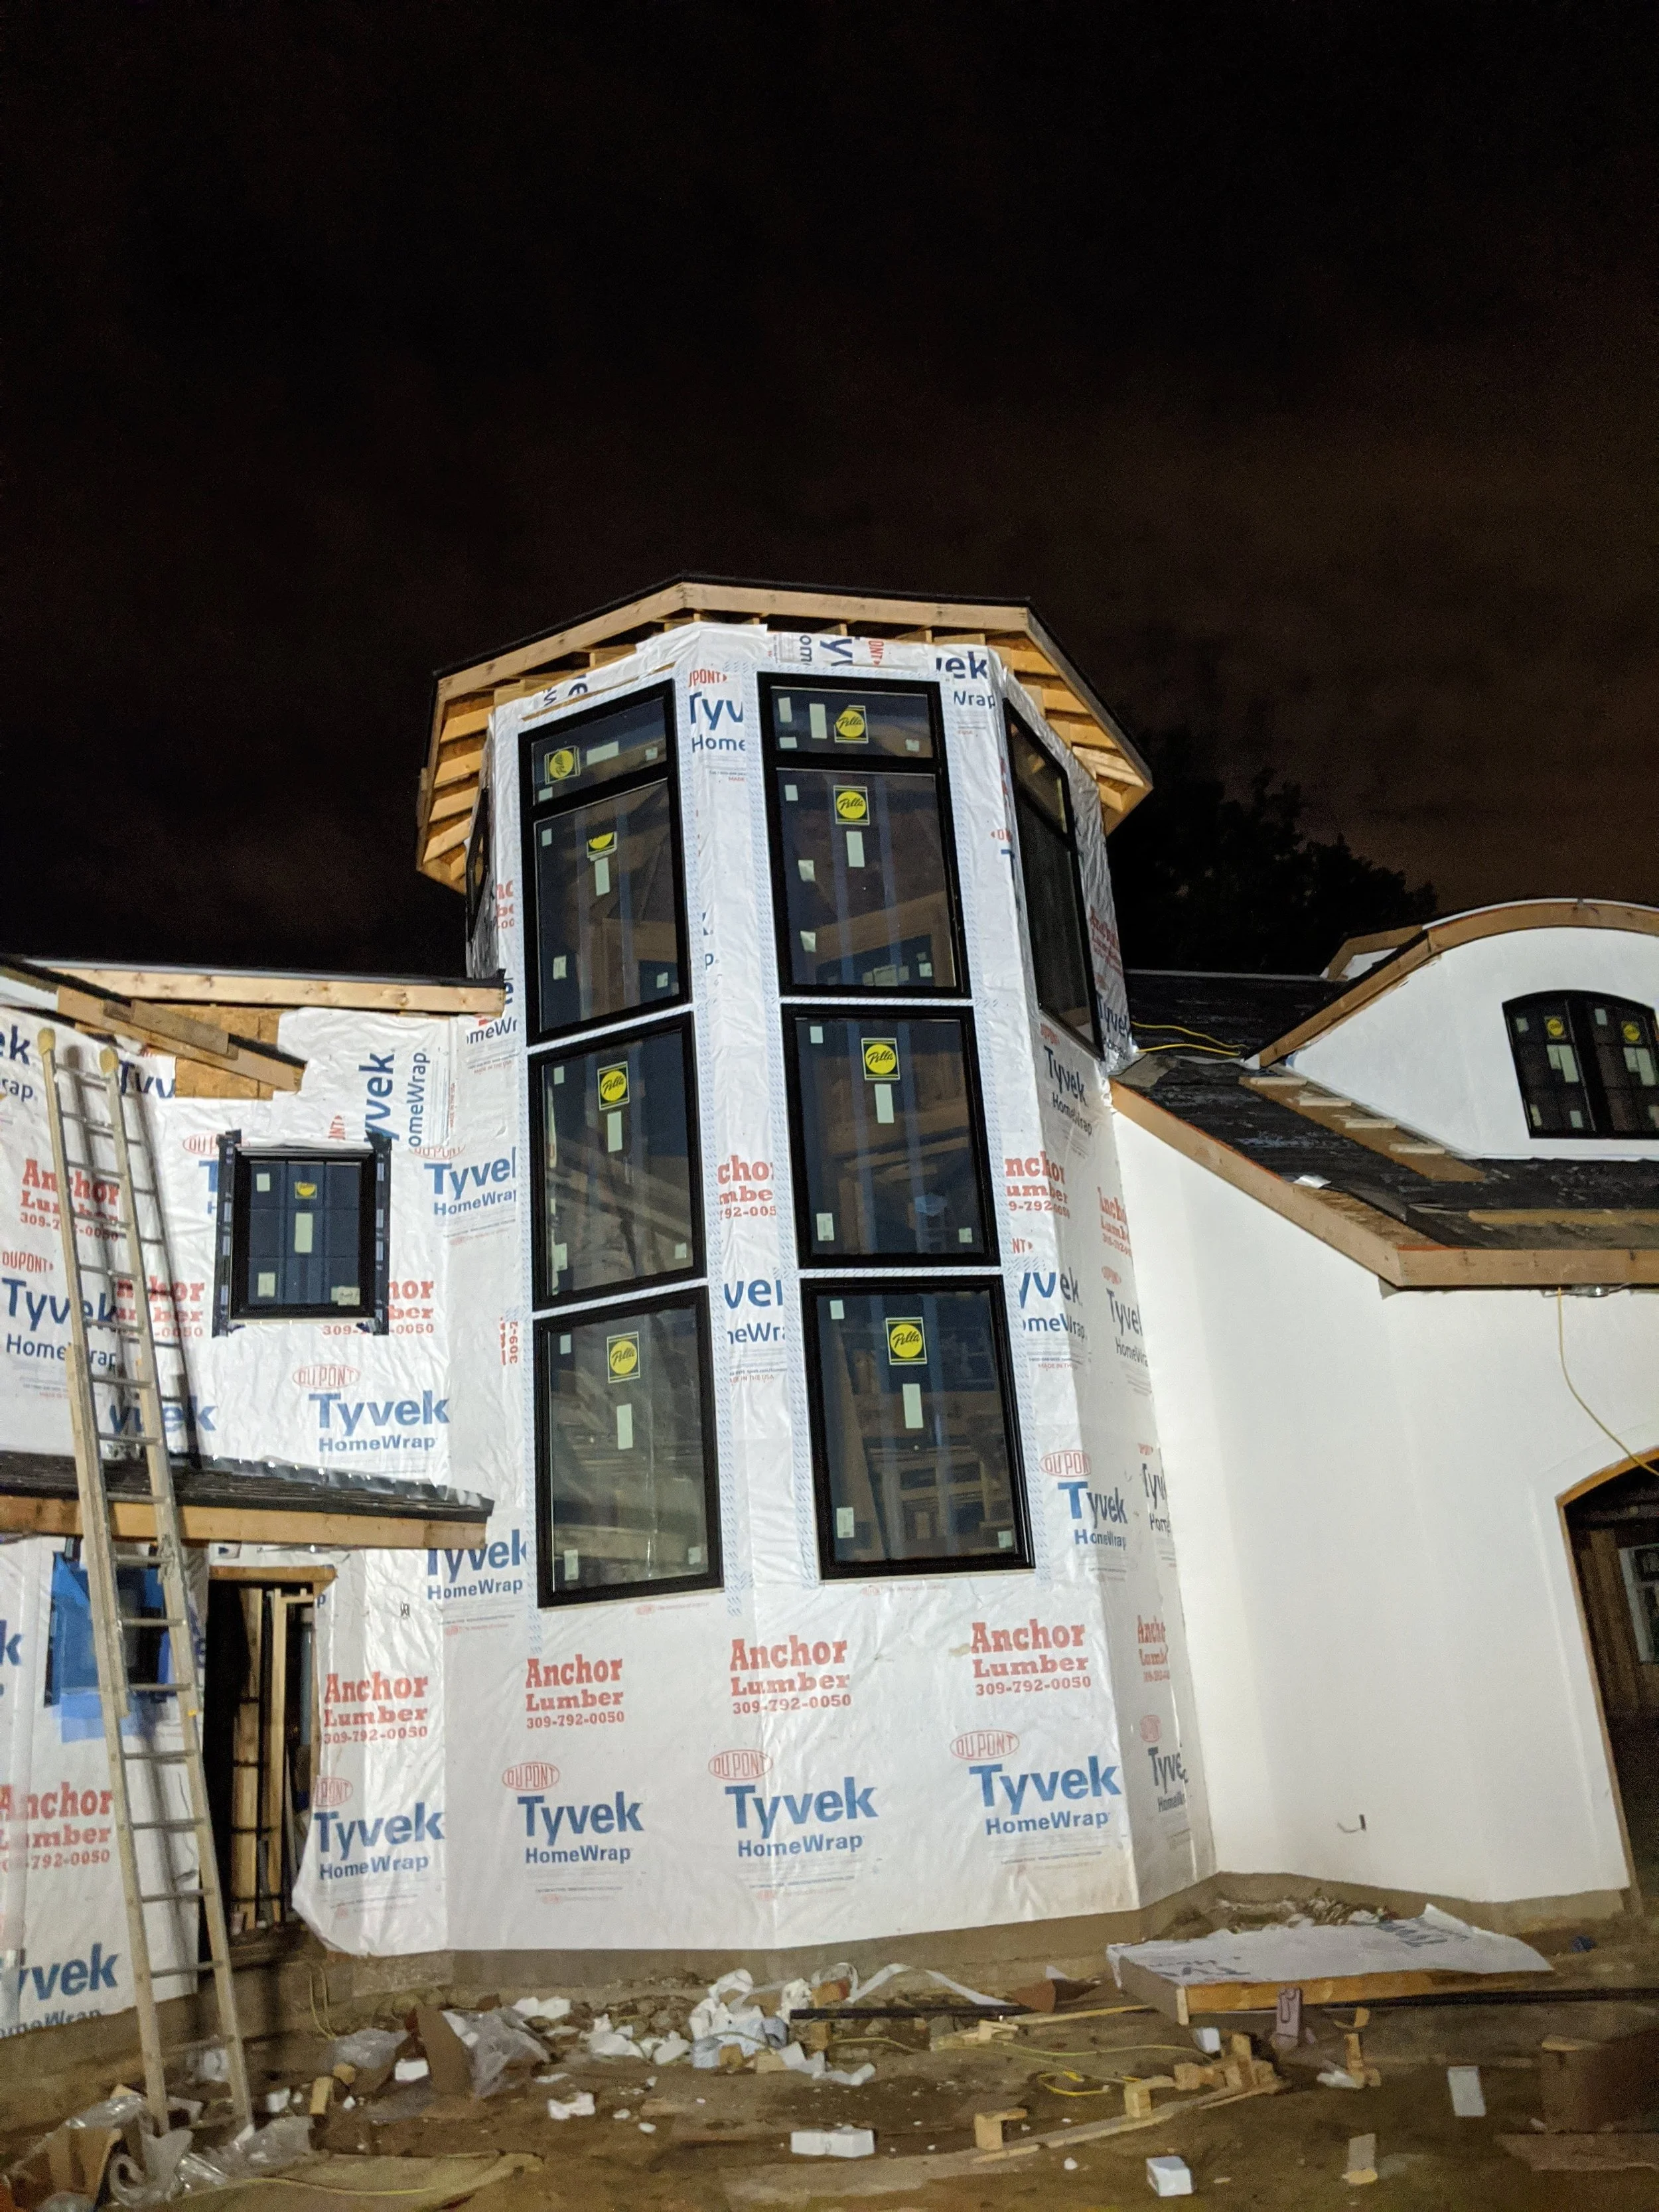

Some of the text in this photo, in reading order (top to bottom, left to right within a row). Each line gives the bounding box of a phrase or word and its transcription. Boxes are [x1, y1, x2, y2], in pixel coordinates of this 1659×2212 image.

[838, 798, 865, 810] Pella
[467, 1017, 518, 1044] meWr
[867, 1052, 894, 1066] Pella
[602, 1076, 625, 1094] Pella
[22, 1159, 119, 1206] Anhor
[892, 1330, 921, 1346] Pella
[1023, 1313, 1086, 1341] meWrap
[611, 1347, 635, 1368] Pella
[309, 1390, 450, 1436] Tyvek
[319, 1434, 436, 1452] HomeWrap
[1058, 1481, 1127, 1529] Tyvek
[427, 1579, 524, 1601] HomeWrap
[971, 1619, 1086, 1654] Anchor
[730, 1635, 848, 1671] Anchor
[526, 1654, 622, 1689] Anchor
[973, 1655, 1089, 1678] Lumber
[324, 1670, 429, 1704] Anchor
[731, 1672, 850, 1697] Lumber
[975, 1676, 1092, 1696] 309-792-0050
[526, 1689, 624, 1712] Lumber
[733, 1694, 852, 1715] 309-792-0050
[324, 1705, 428, 1728] Lumber
[526, 1711, 625, 1730] 309-792-0050
[323, 1726, 428, 1745] 309-792-0050
[969, 1755, 1123, 1815] Tyvek
[518, 1791, 645, 1846] Tyvek
[725, 1776, 879, 1839] Tyvek
[314, 1802, 447, 1861] Tyvek
[986, 1810, 1110, 1836] HomeWrap
[525, 1845, 632, 1864] HomeWrap
[738, 1834, 863, 1858] HomeWrap
[320, 1854, 429, 1880] HomeWrap
